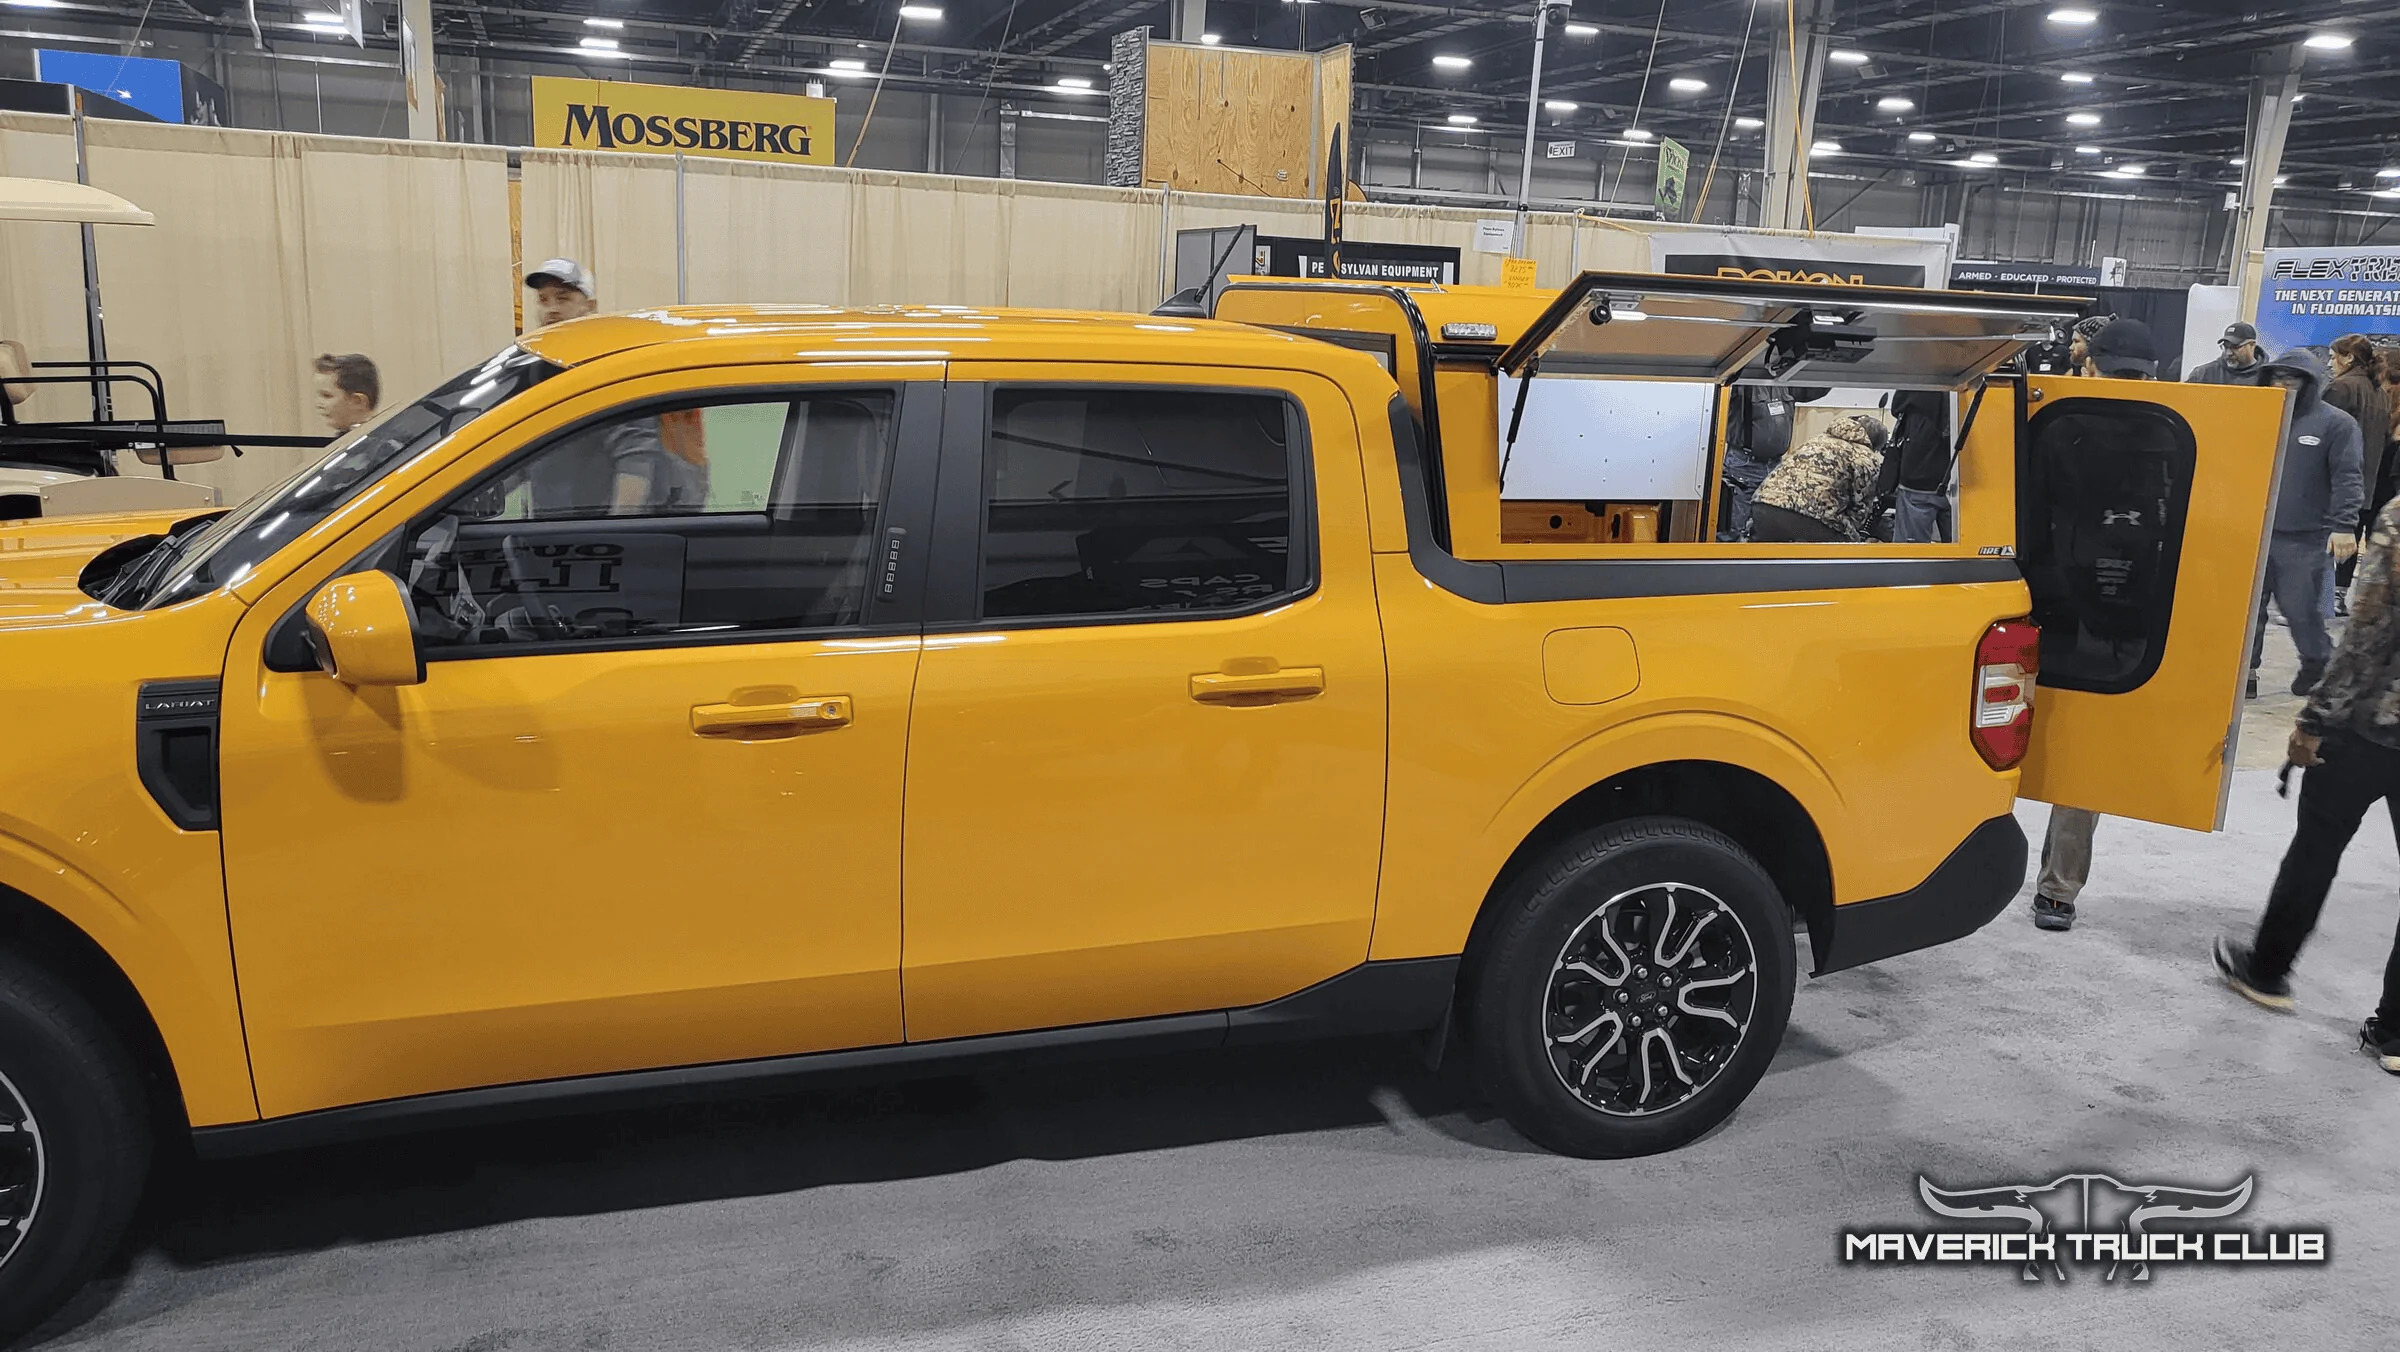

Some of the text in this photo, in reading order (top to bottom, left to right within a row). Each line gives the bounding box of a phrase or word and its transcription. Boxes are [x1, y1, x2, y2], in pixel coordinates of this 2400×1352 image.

[561, 103, 811, 156] MOSSBERG
[1553, 146, 1574, 156] EXIT
[1381, 265, 1439, 278] EQUIPMENT
[1958, 271, 2097, 285] ARMED EDUCATED PROTECTED
[2275, 290, 2298, 301] THE
[2300, 290, 2334, 301] NEXT
[2292, 303, 2306, 314] IN
[145, 699, 215, 710] LARIAT
